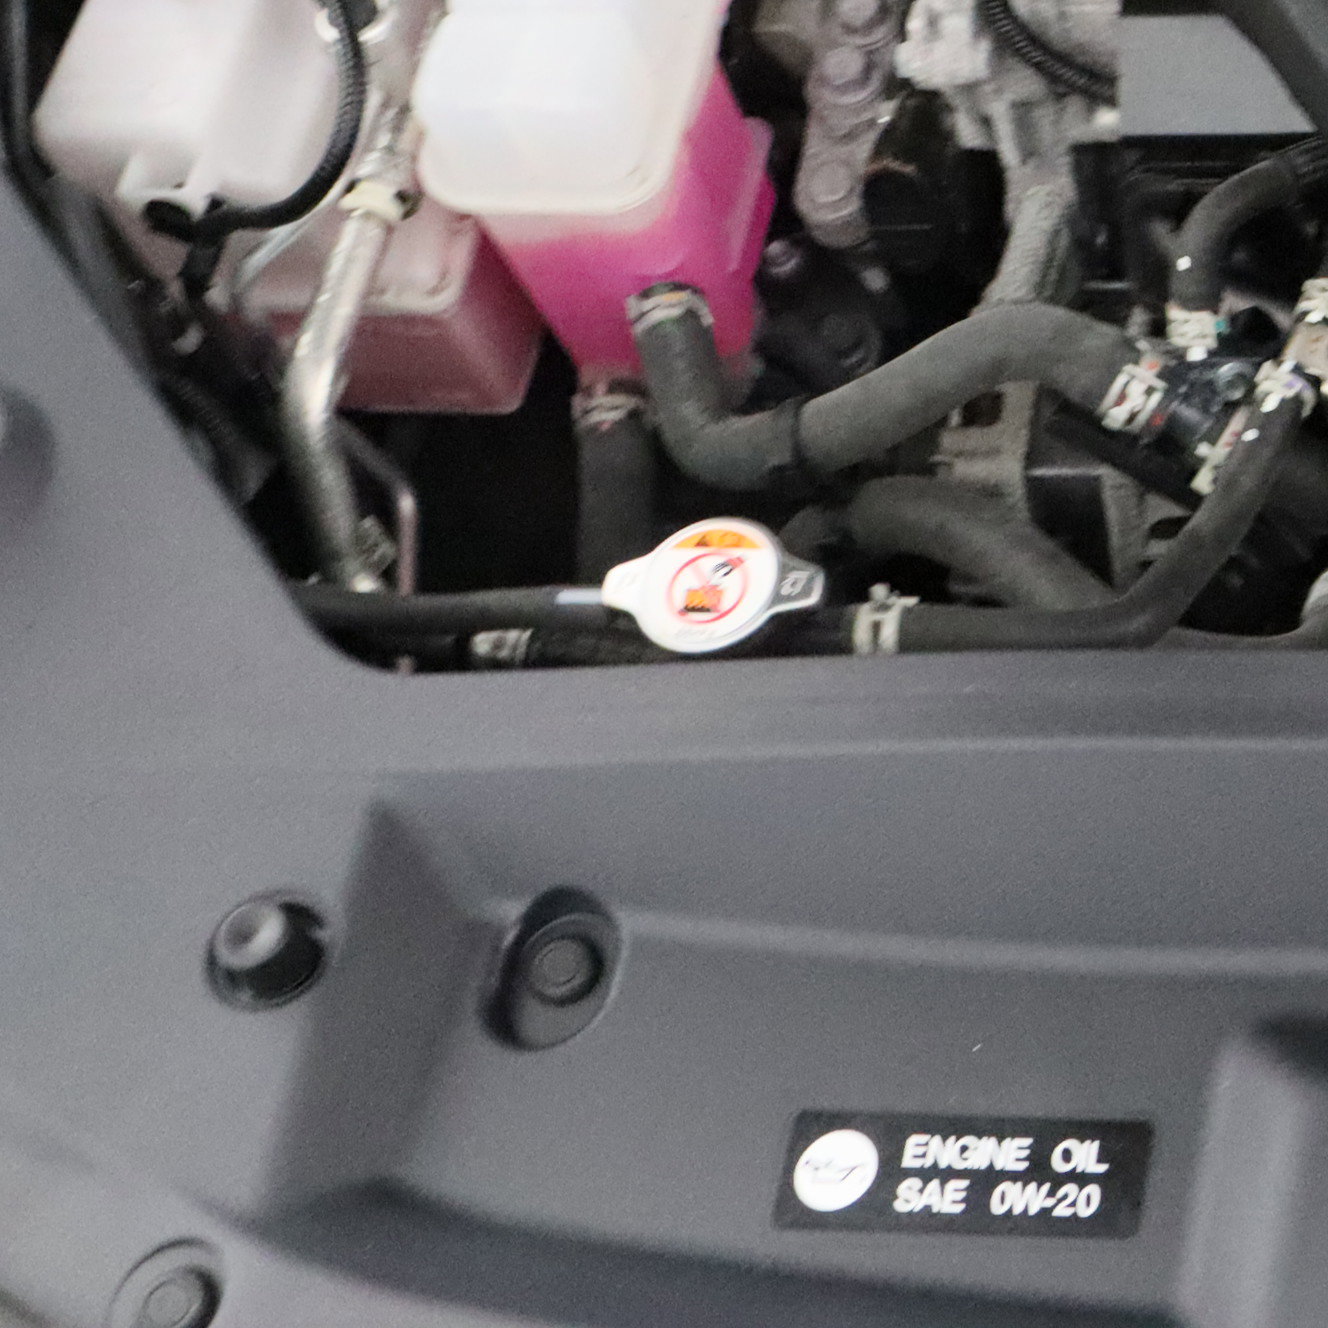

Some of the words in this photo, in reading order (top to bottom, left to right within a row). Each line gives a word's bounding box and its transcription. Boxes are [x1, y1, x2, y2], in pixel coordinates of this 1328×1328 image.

[901, 1133, 1034, 1171] ENGINE
[1050, 1138, 1110, 1174] OIL
[892, 1177, 971, 1214] SAE
[989, 1180, 1102, 1218] 0W-20
